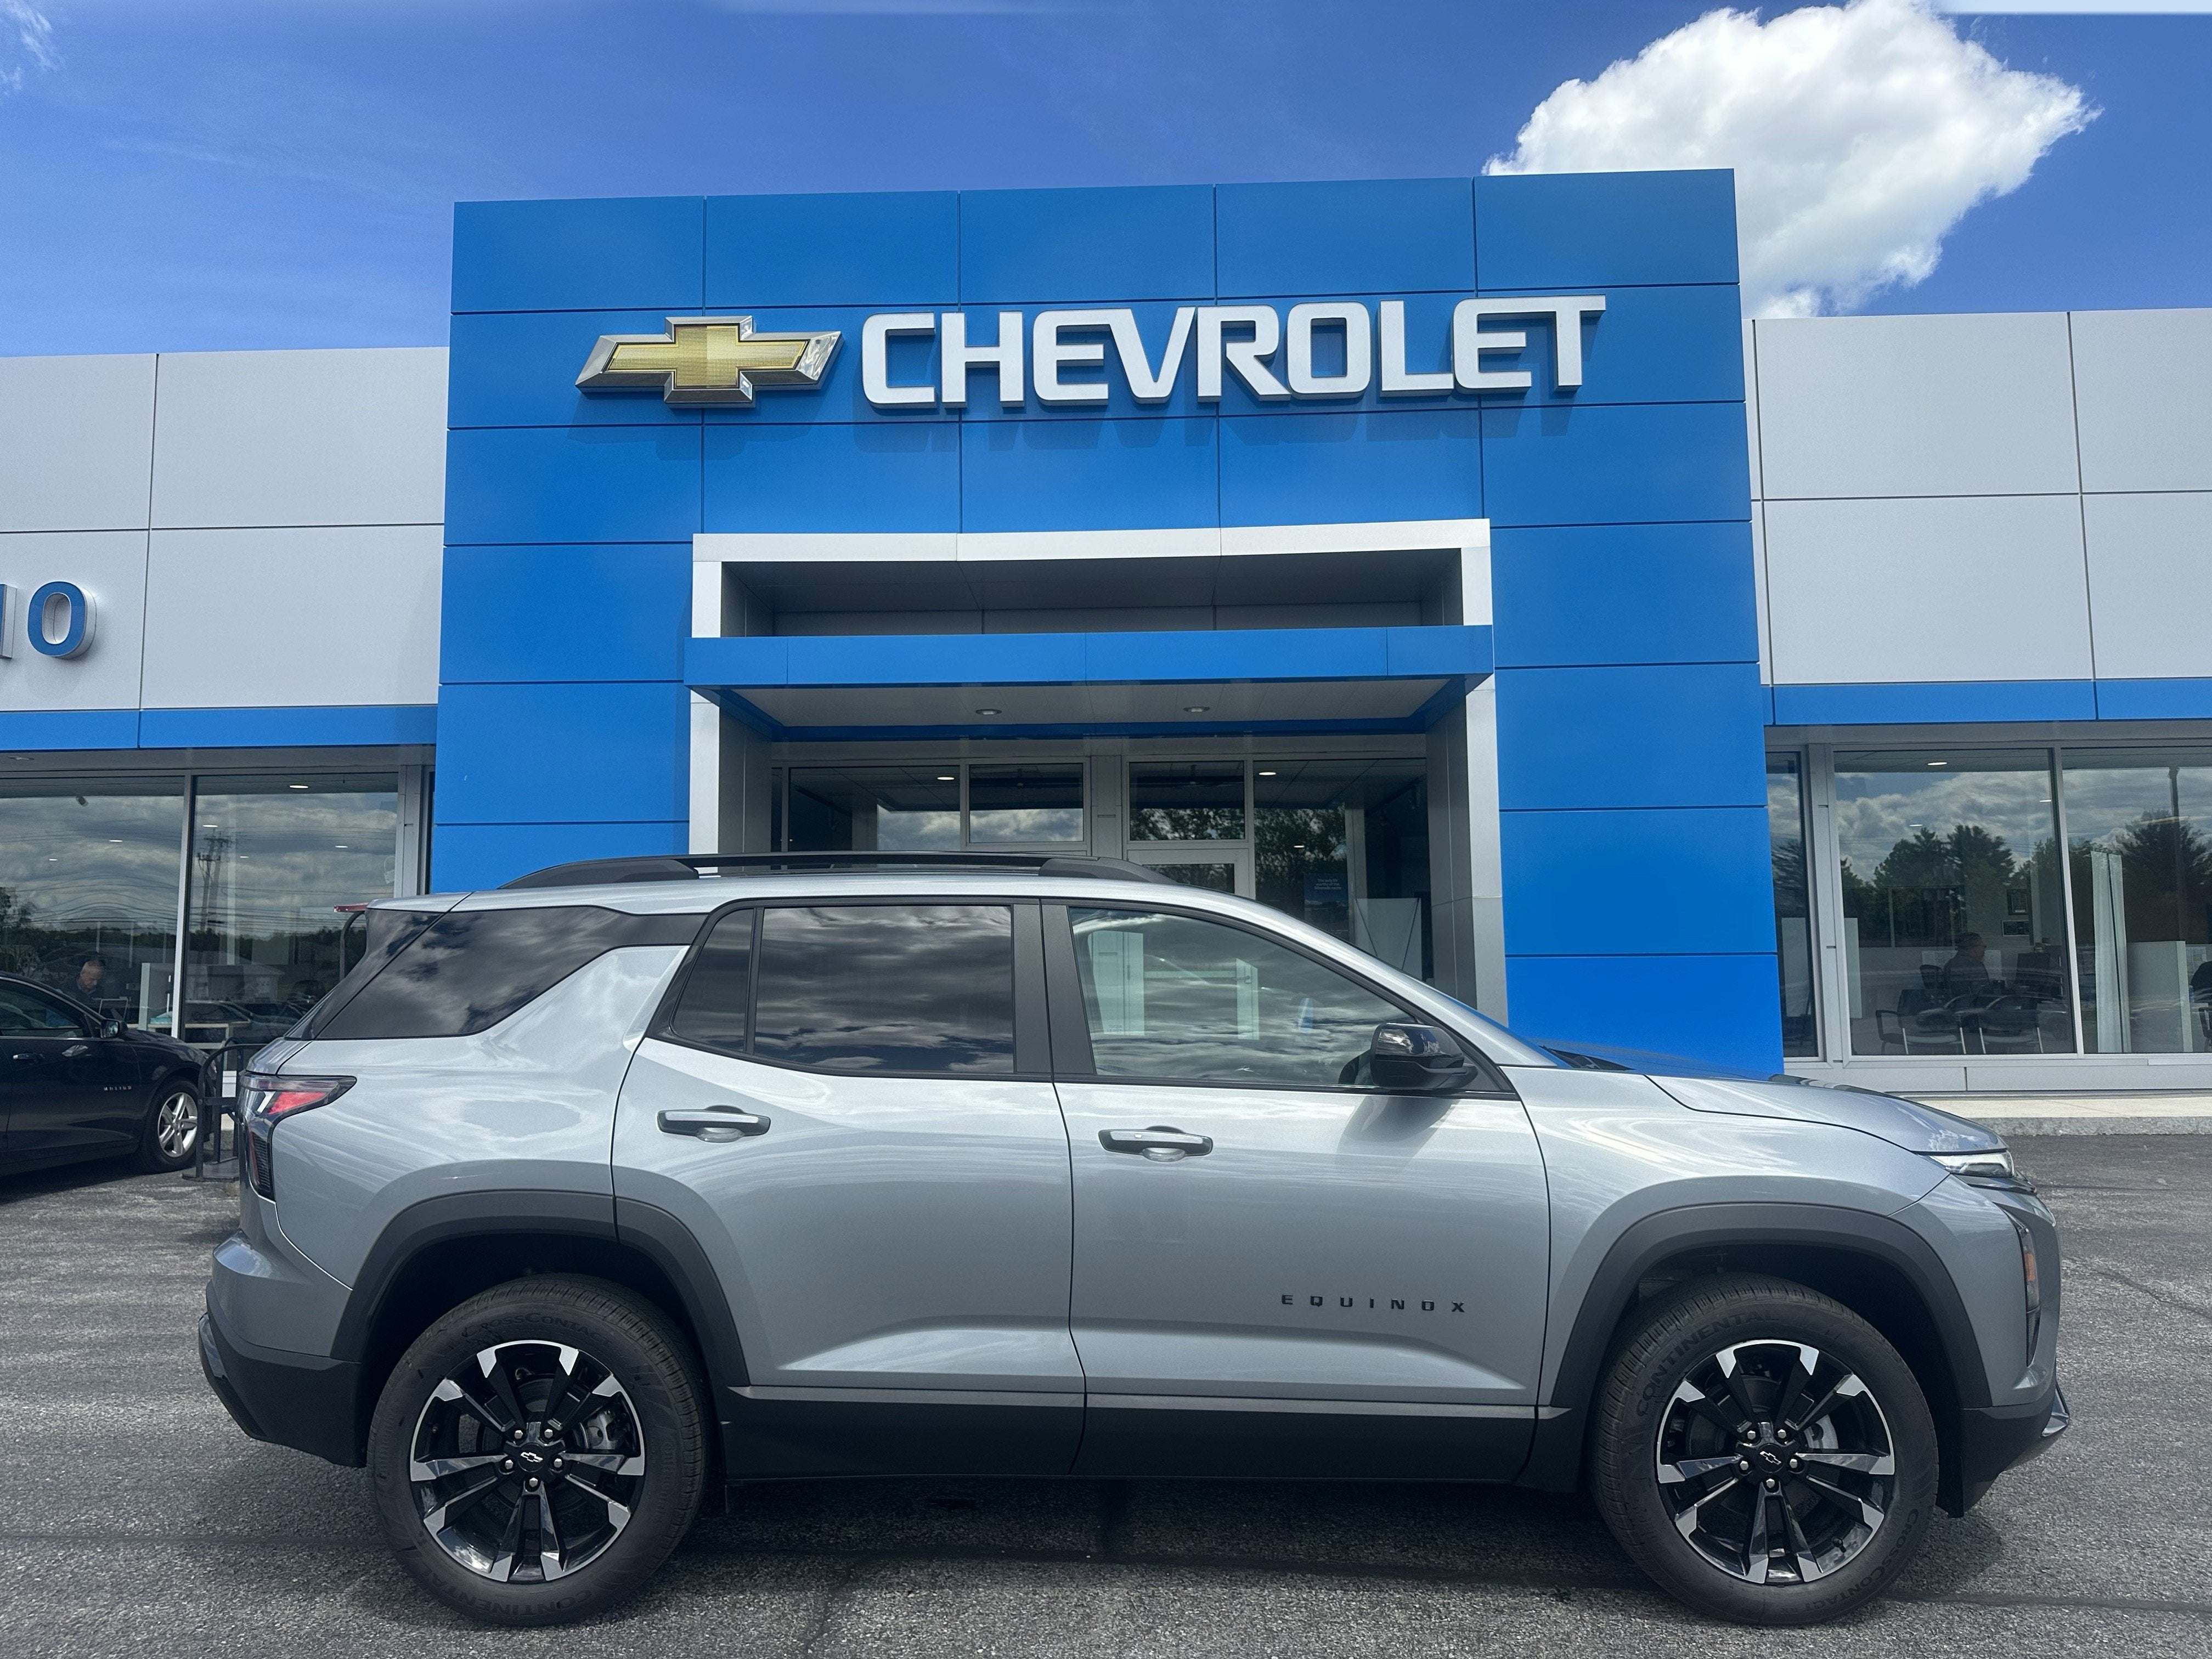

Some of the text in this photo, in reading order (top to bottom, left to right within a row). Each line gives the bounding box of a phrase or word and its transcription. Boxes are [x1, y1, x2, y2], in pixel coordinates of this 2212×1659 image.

[861, 294, 1606, 410] CHEVROLET
[0, 580, 97, 658] O
[1280, 1294, 1465, 1313] EQUINOX
[1637, 1311, 1779, 1417] CONTINENTAL
